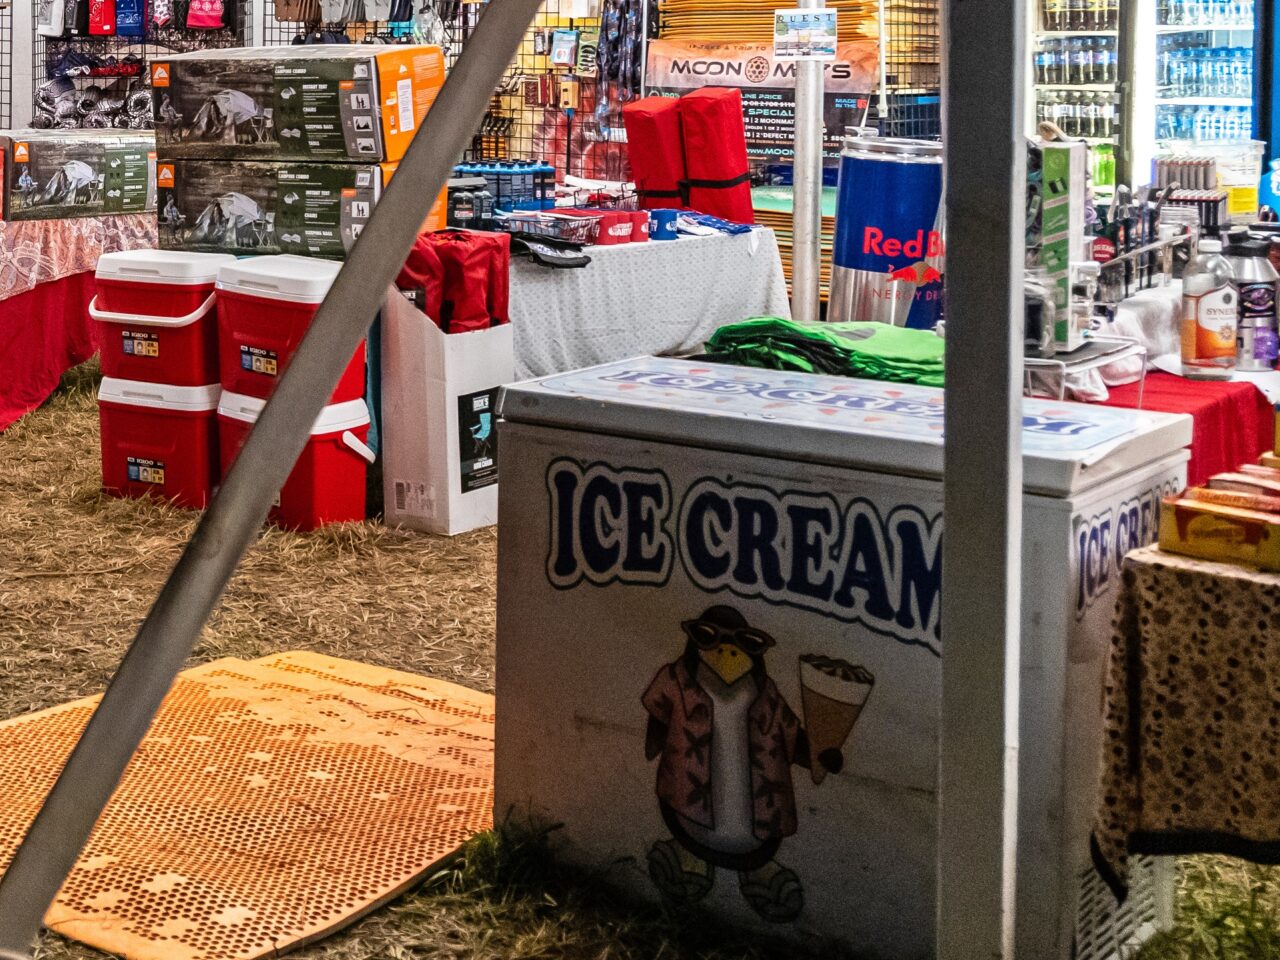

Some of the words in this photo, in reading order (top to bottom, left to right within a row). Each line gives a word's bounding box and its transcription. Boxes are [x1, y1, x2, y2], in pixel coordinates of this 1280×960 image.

[777, 13, 834, 23] QUEST
[670, 60, 742, 76] MOON
[773, 63, 850, 79] MS
[857, 100, 867, 108] US
[863, 226, 923, 258] Red
[549, 464, 669, 583] ICE
[680, 484, 944, 635] CREAM
[1076, 511, 1112, 616] ICE
